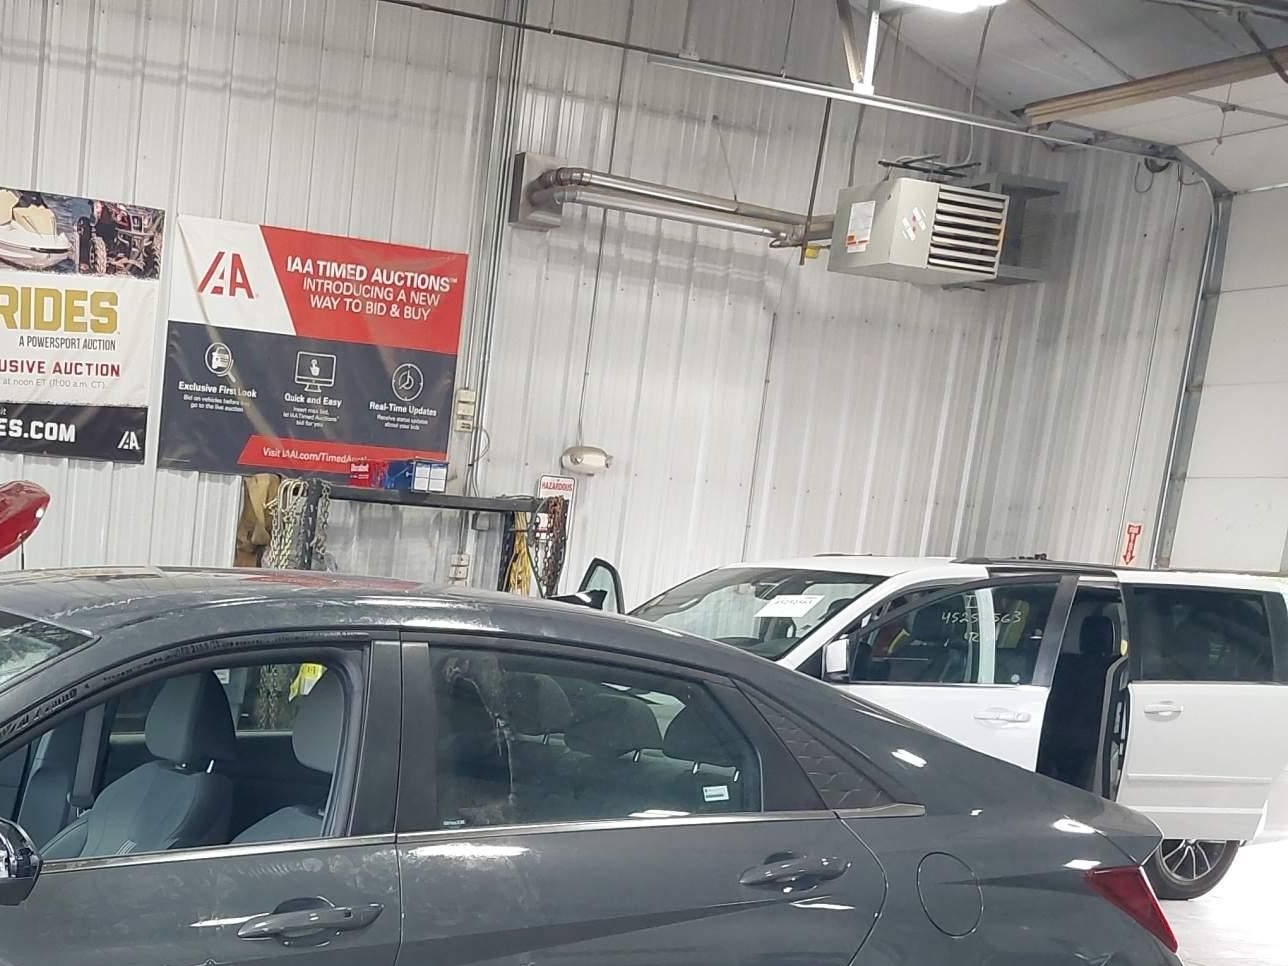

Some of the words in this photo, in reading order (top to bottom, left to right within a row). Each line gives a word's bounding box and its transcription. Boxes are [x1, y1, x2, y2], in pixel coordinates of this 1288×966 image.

[286, 255, 313, 275] IAA
[316, 260, 367, 281] TIMED
[303, 277, 393, 301] INTRODUCING
[396, 289, 406, 303] A
[410, 291, 440, 307] NEW
[310, 294, 341, 310] WAY
[343, 298, 362, 313] TO
[365, 301, 387, 316] BID
[390, 304, 400, 318] &
[403, 306, 431, 321] BUY
[18, 335, 25, 347] A
[27, 335, 81, 350] POWERSPORT
[82, 338, 116, 351] AUCTION
[52, 361, 121, 377] AUCTION
[12, 378, 34, 386] noon
[178, 381, 217, 393] Exclusive
[219, 384, 237, 395] First
[238, 388, 257, 398] Look
[284, 392, 305, 403] Quick
[306, 397, 321, 405] and
[323, 396, 342, 408] Easy
[369, 401, 407, 413] Real-Time
[408, 405, 437, 417] Updates
[263, 447, 280, 458] Visit
[541, 481, 573, 492] HAZARDOUS
